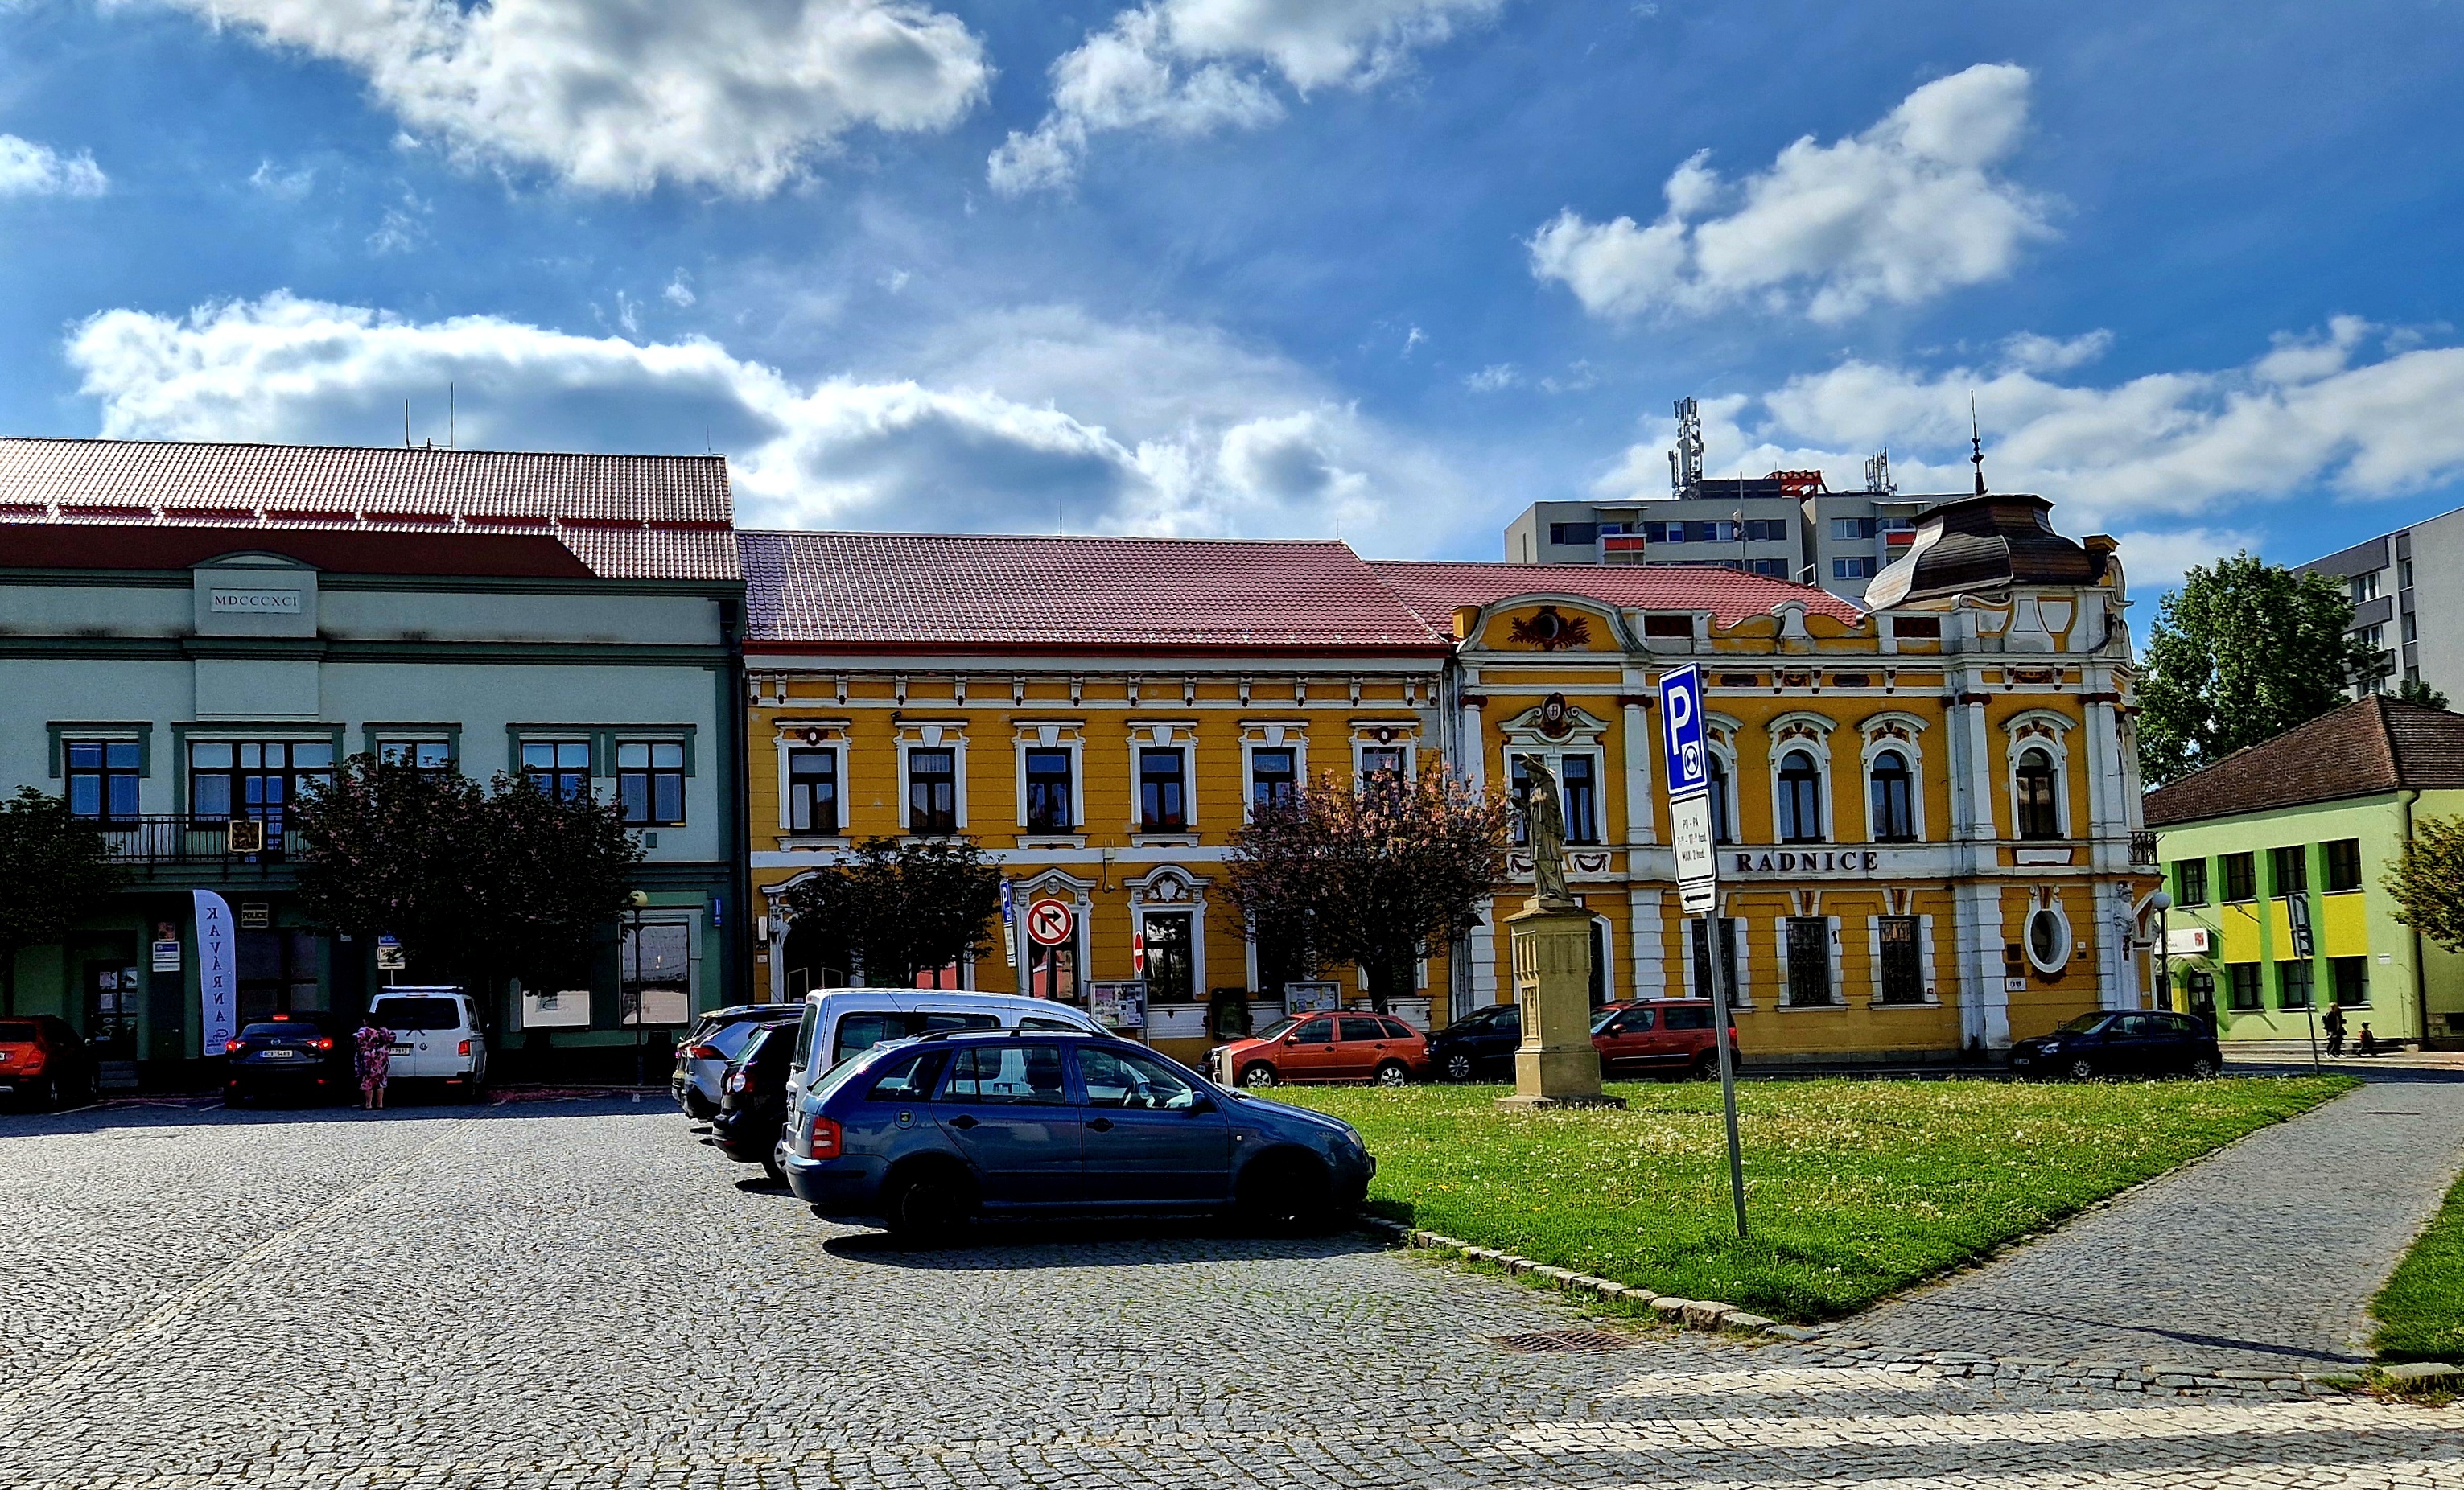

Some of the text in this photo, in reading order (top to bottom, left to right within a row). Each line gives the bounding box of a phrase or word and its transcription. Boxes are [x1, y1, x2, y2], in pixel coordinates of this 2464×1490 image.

[214, 595, 298, 607] MDCCCXCI
[1667, 685, 1691, 755] P
[1735, 851, 1878, 872] RADNICE
[243, 911, 268, 920] POLICIE
